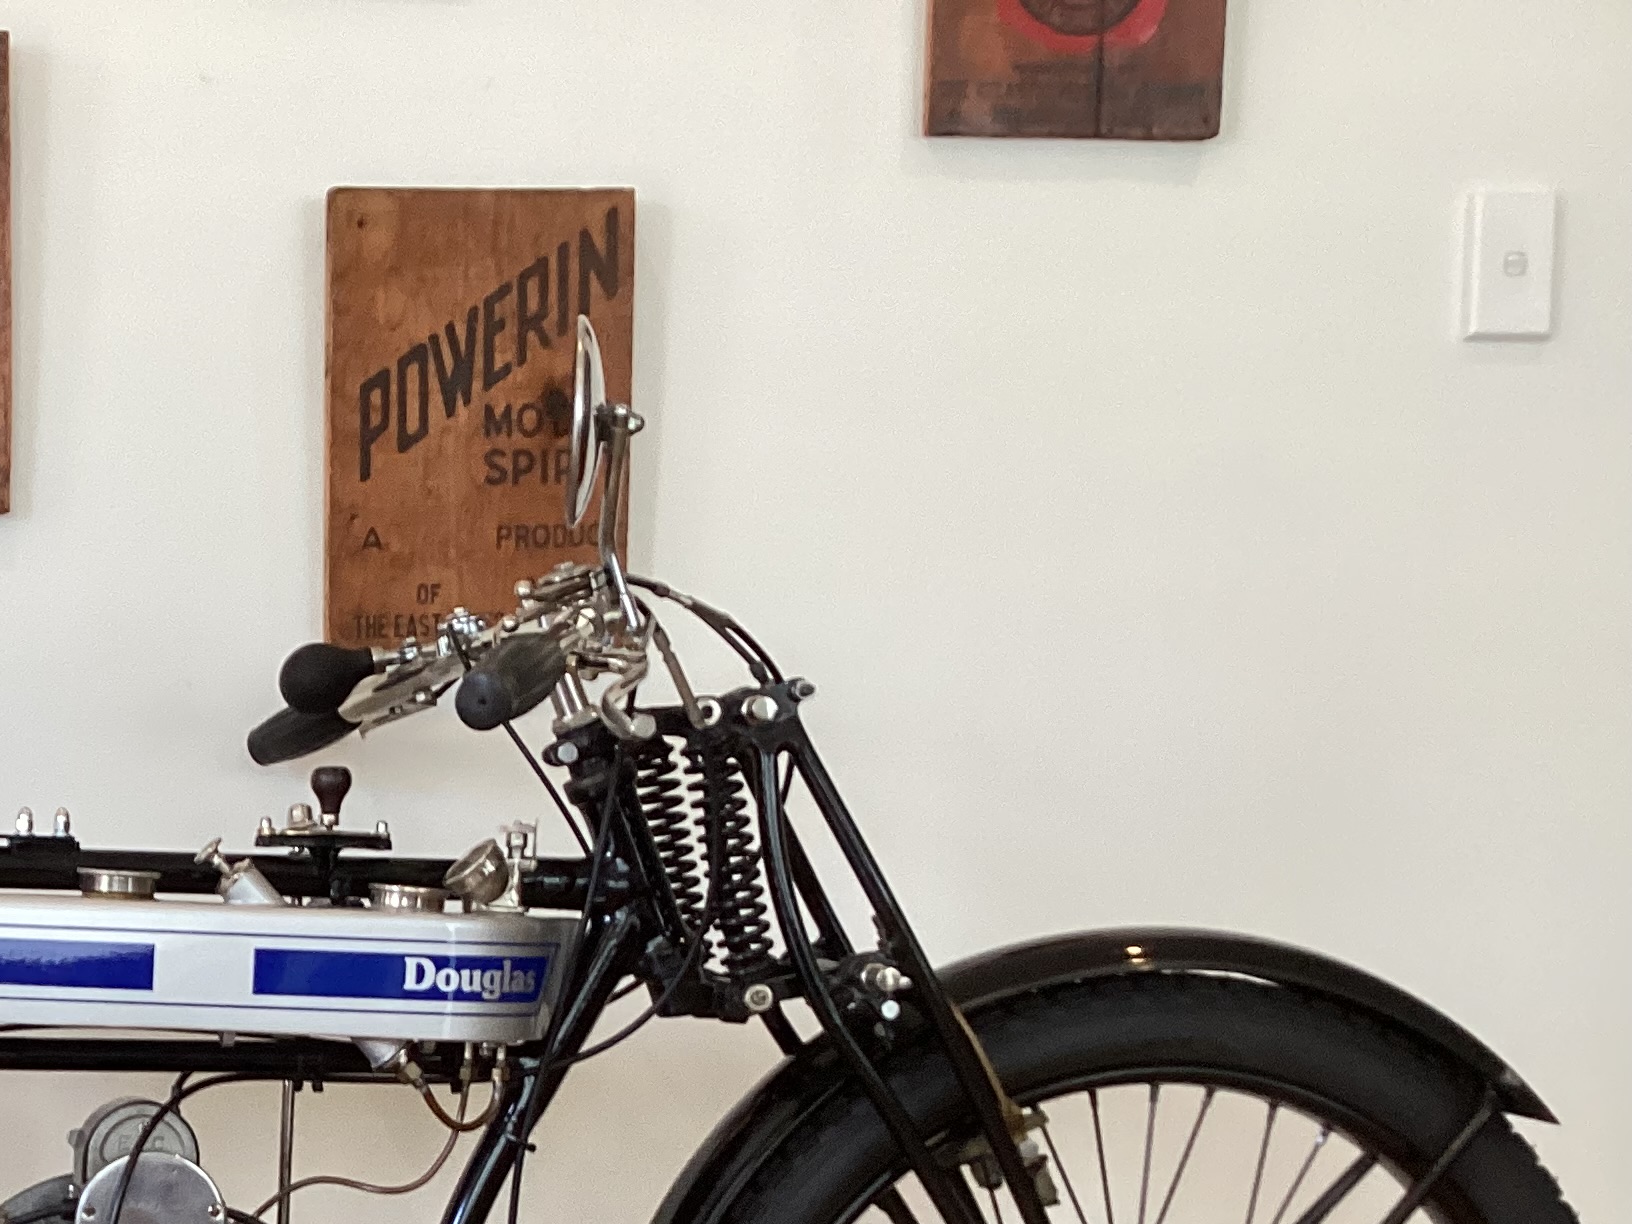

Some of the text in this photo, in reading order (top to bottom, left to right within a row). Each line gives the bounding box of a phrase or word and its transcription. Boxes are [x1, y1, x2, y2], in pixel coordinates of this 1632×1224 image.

[359, 206, 619, 482] POWERIN
[361, 522, 600, 550] A PRODUC
[416, 582, 441, 605] OF
[353, 612, 388, 640] THE
[403, 956, 536, 1001] Douglas
